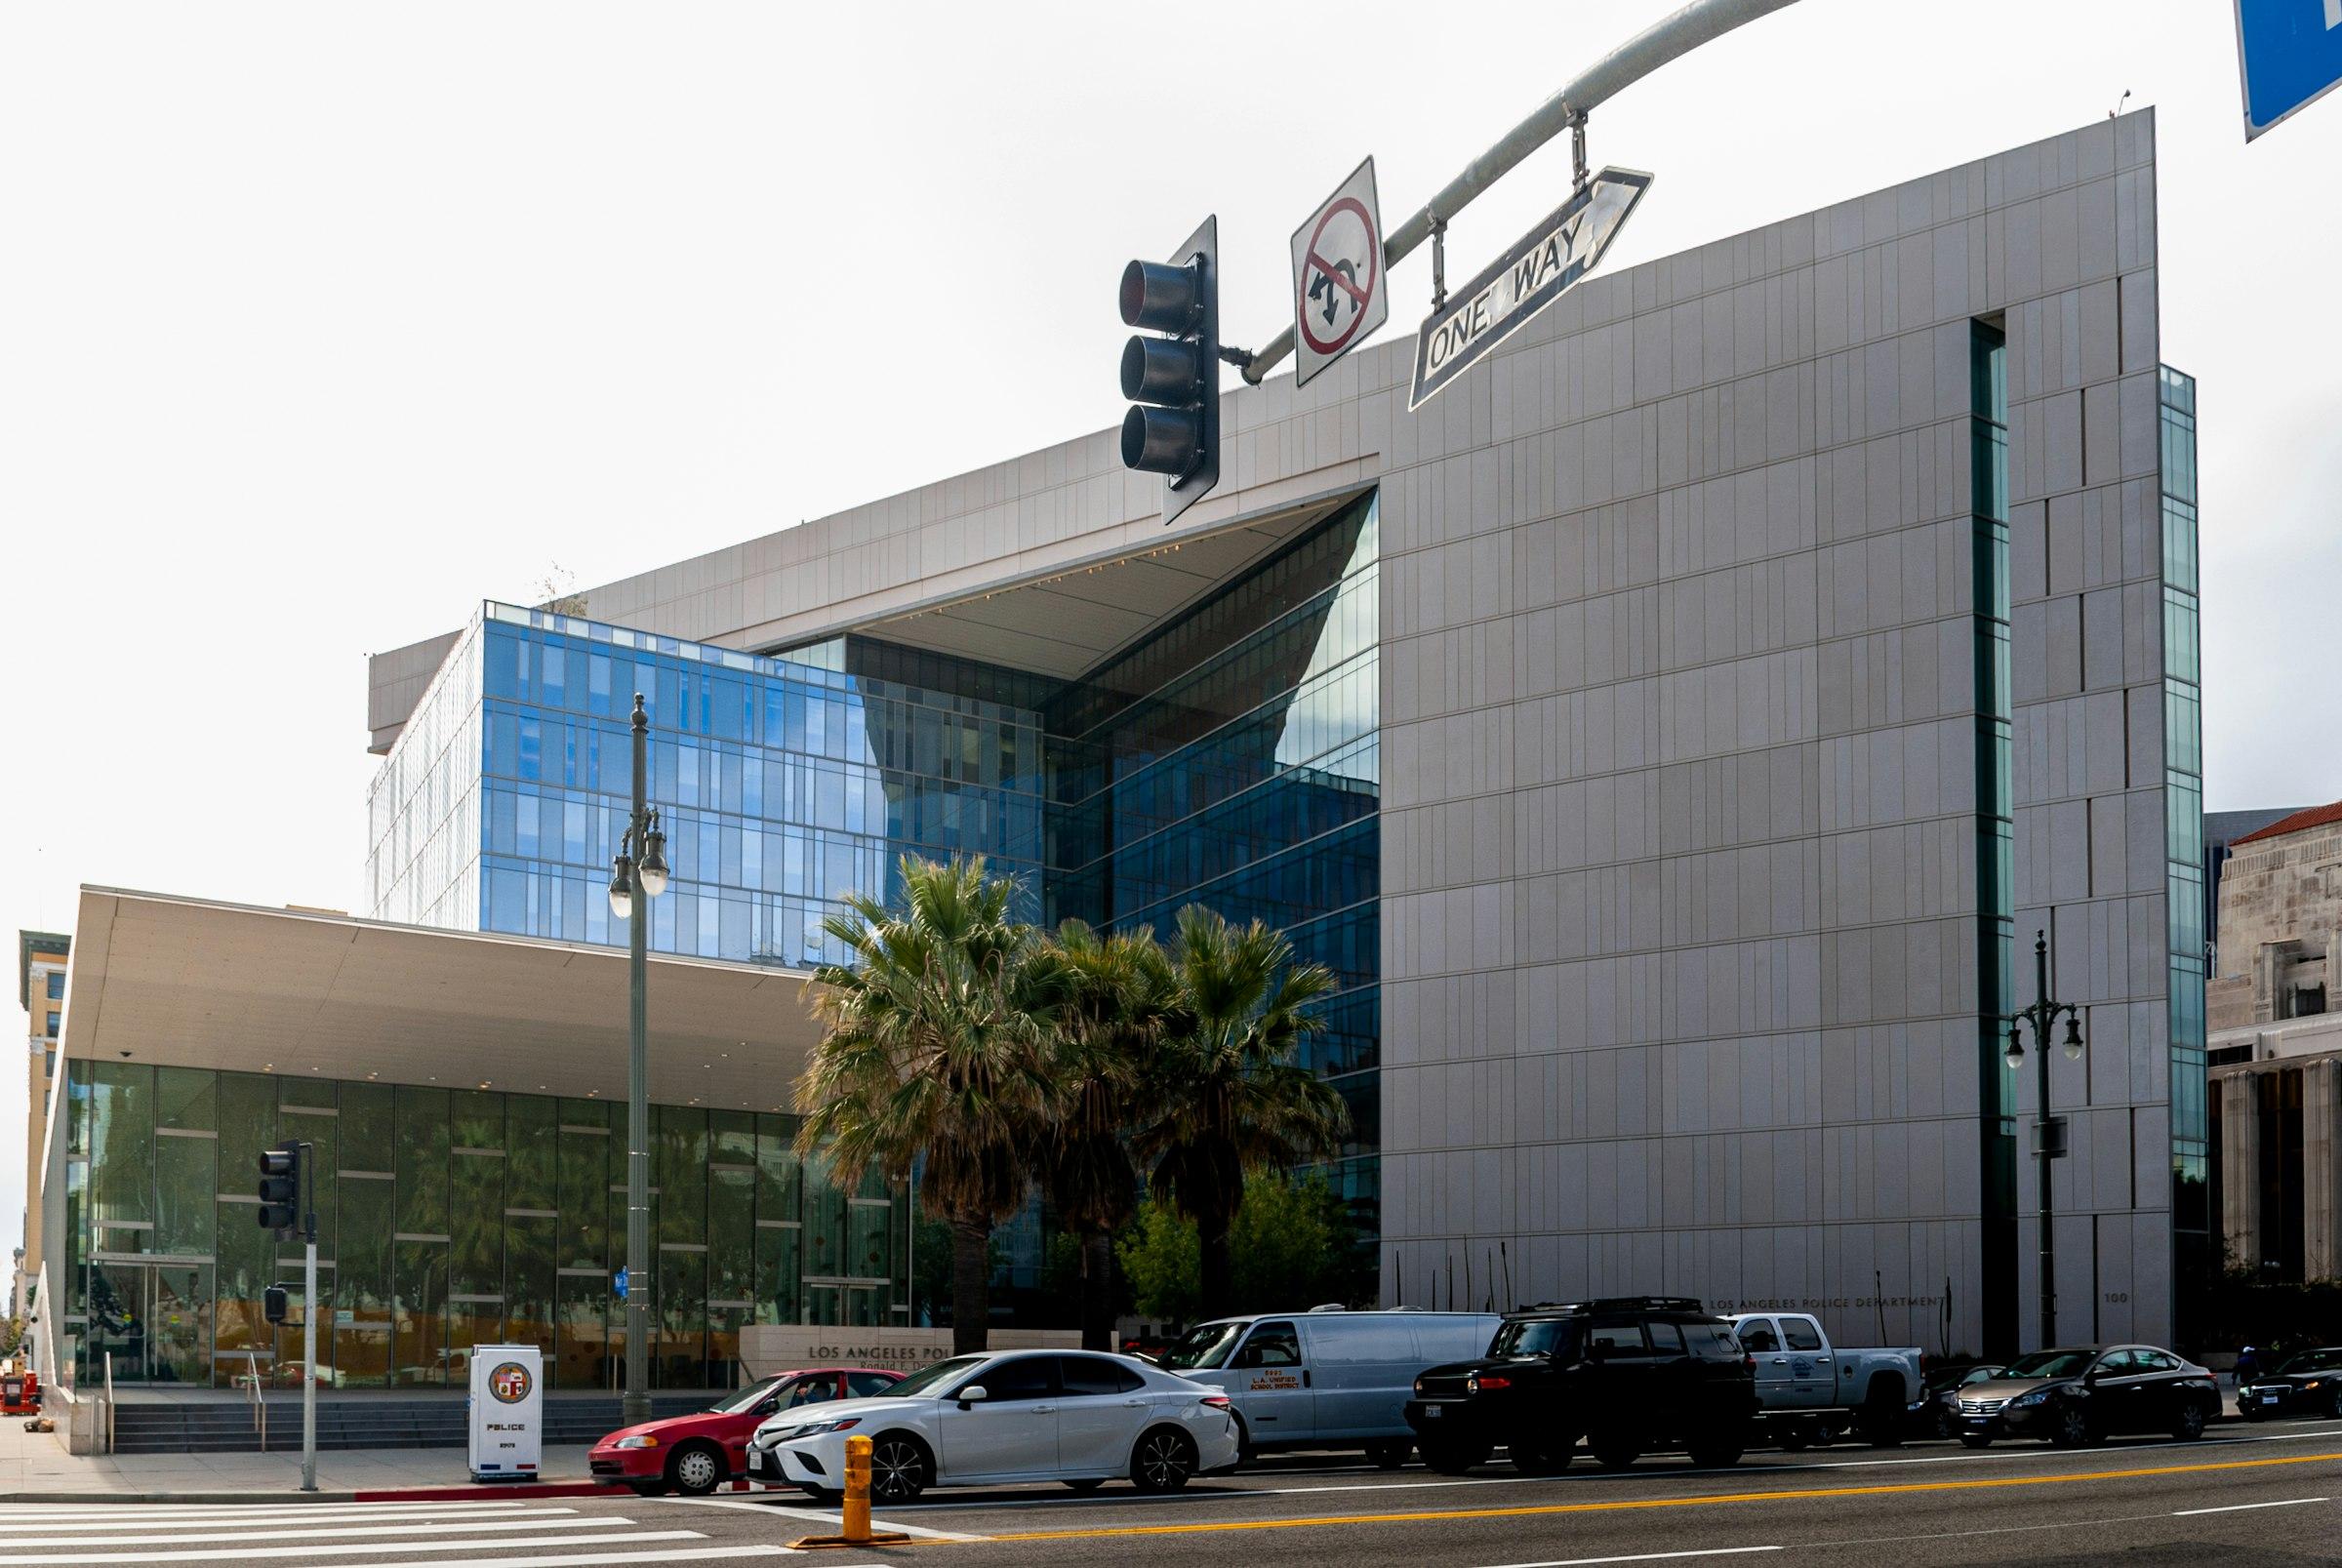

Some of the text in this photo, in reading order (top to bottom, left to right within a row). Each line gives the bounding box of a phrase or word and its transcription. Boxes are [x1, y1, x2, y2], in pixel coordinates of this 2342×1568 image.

[1430, 211, 1586, 369] ONE WAY
[1711, 1299, 1734, 1309] LOS
[1739, 1298, 1796, 1309] ANGELES
[1802, 1298, 1849, 1308] POLICE
[2104, 1293, 2127, 1304] 100
[809, 1346, 949, 1359] LOS ANGELES POL
